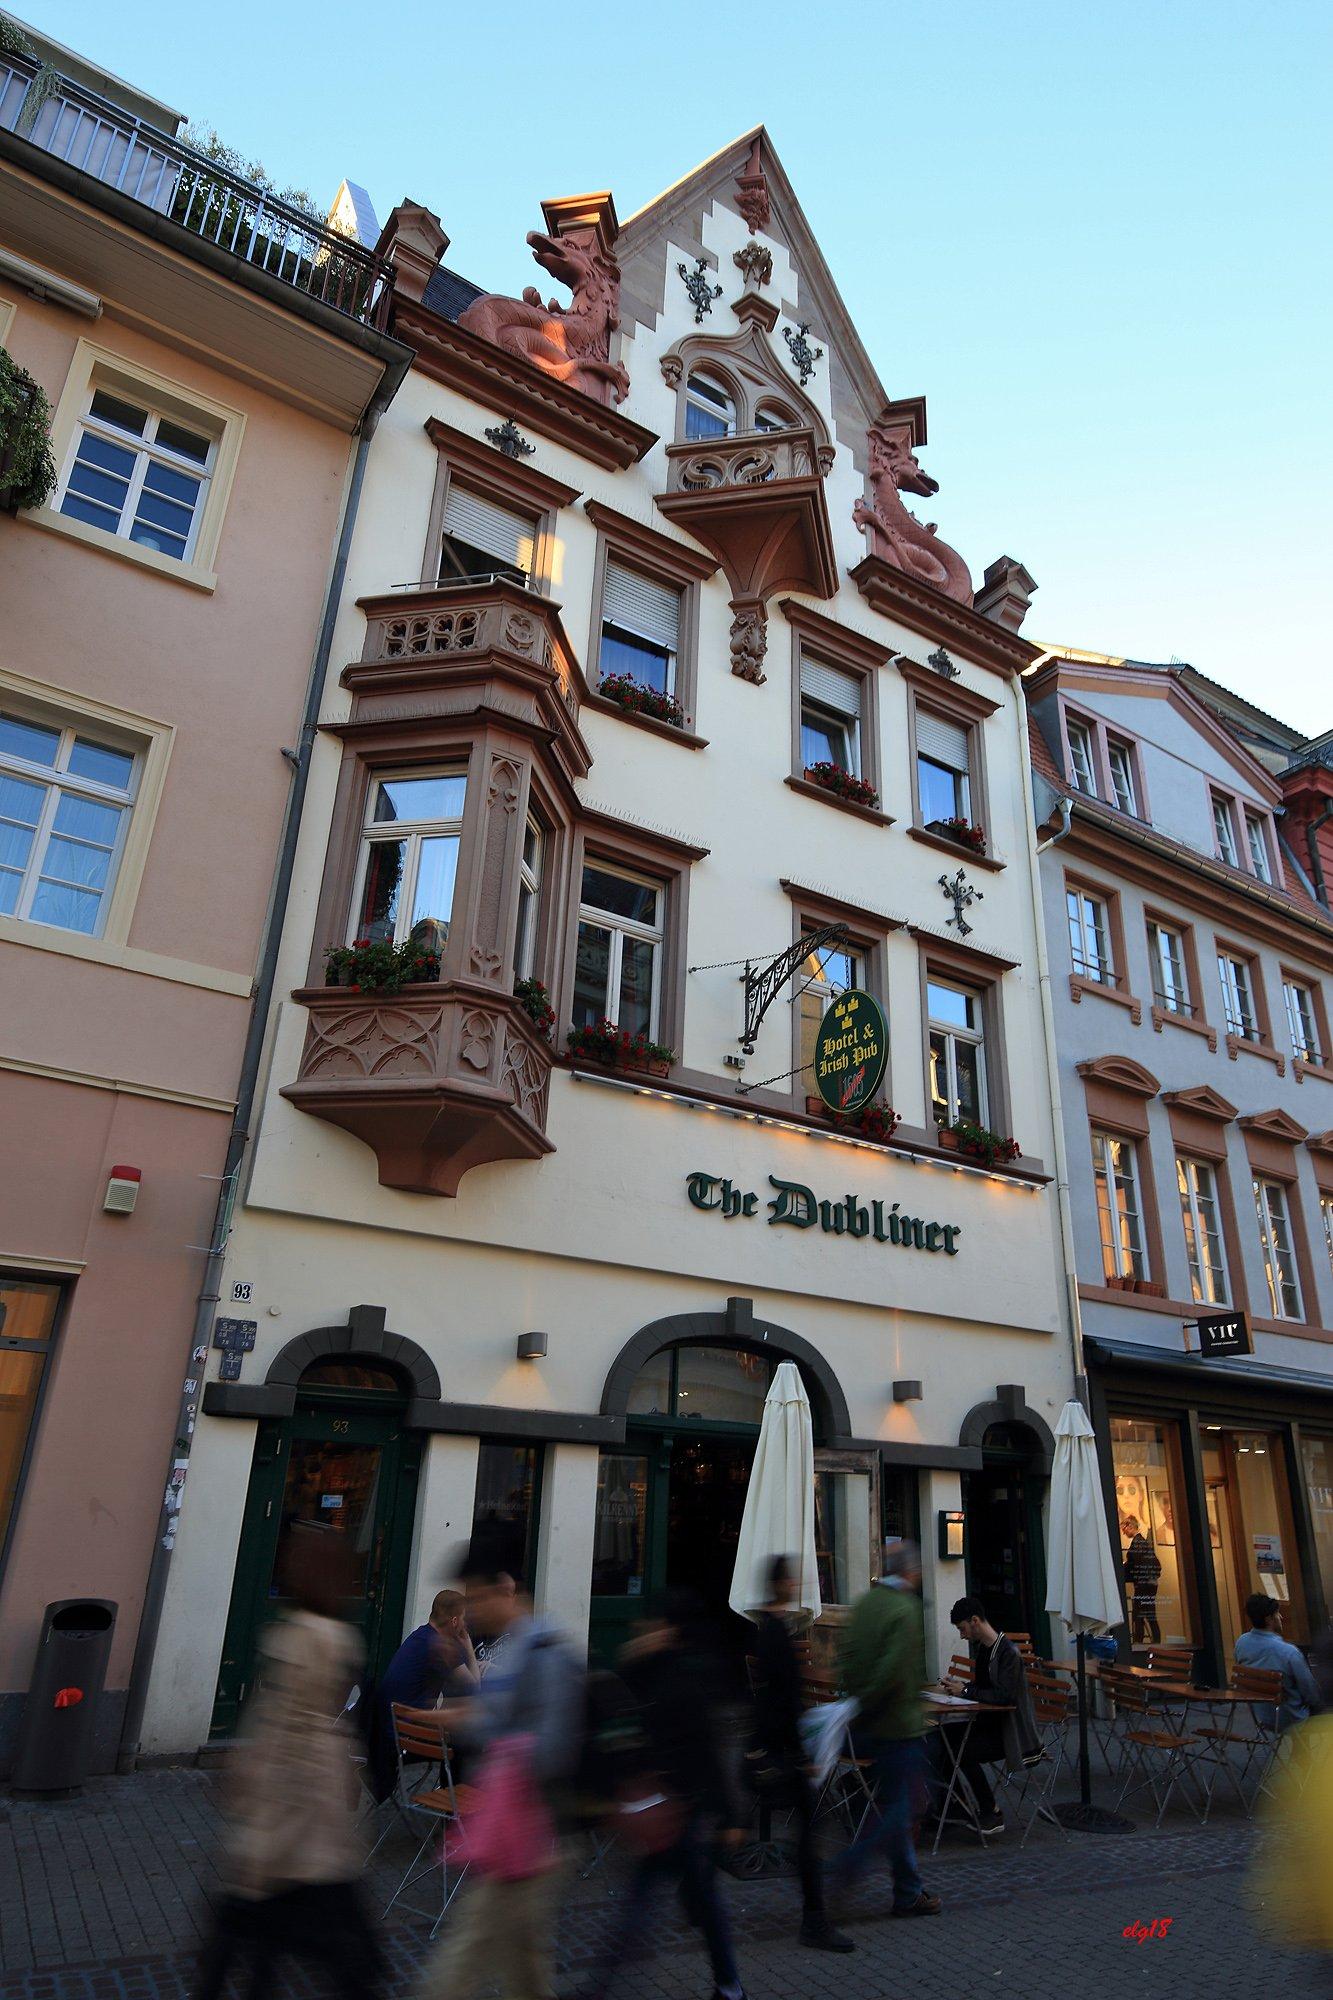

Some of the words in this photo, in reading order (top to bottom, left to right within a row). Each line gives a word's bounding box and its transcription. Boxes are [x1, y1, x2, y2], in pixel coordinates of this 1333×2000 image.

[819, 1053, 849, 1077] Irish
[852, 1041, 878, 1066] Pub
[823, 1027, 859, 1059] Hotel
[863, 1023, 875, 1040] &
[686, 1171, 760, 1219] The
[767, 1174, 962, 1256] Dubliner
[234, 1283, 251, 1300] 93
[333, 1420, 349, 1434] 93
